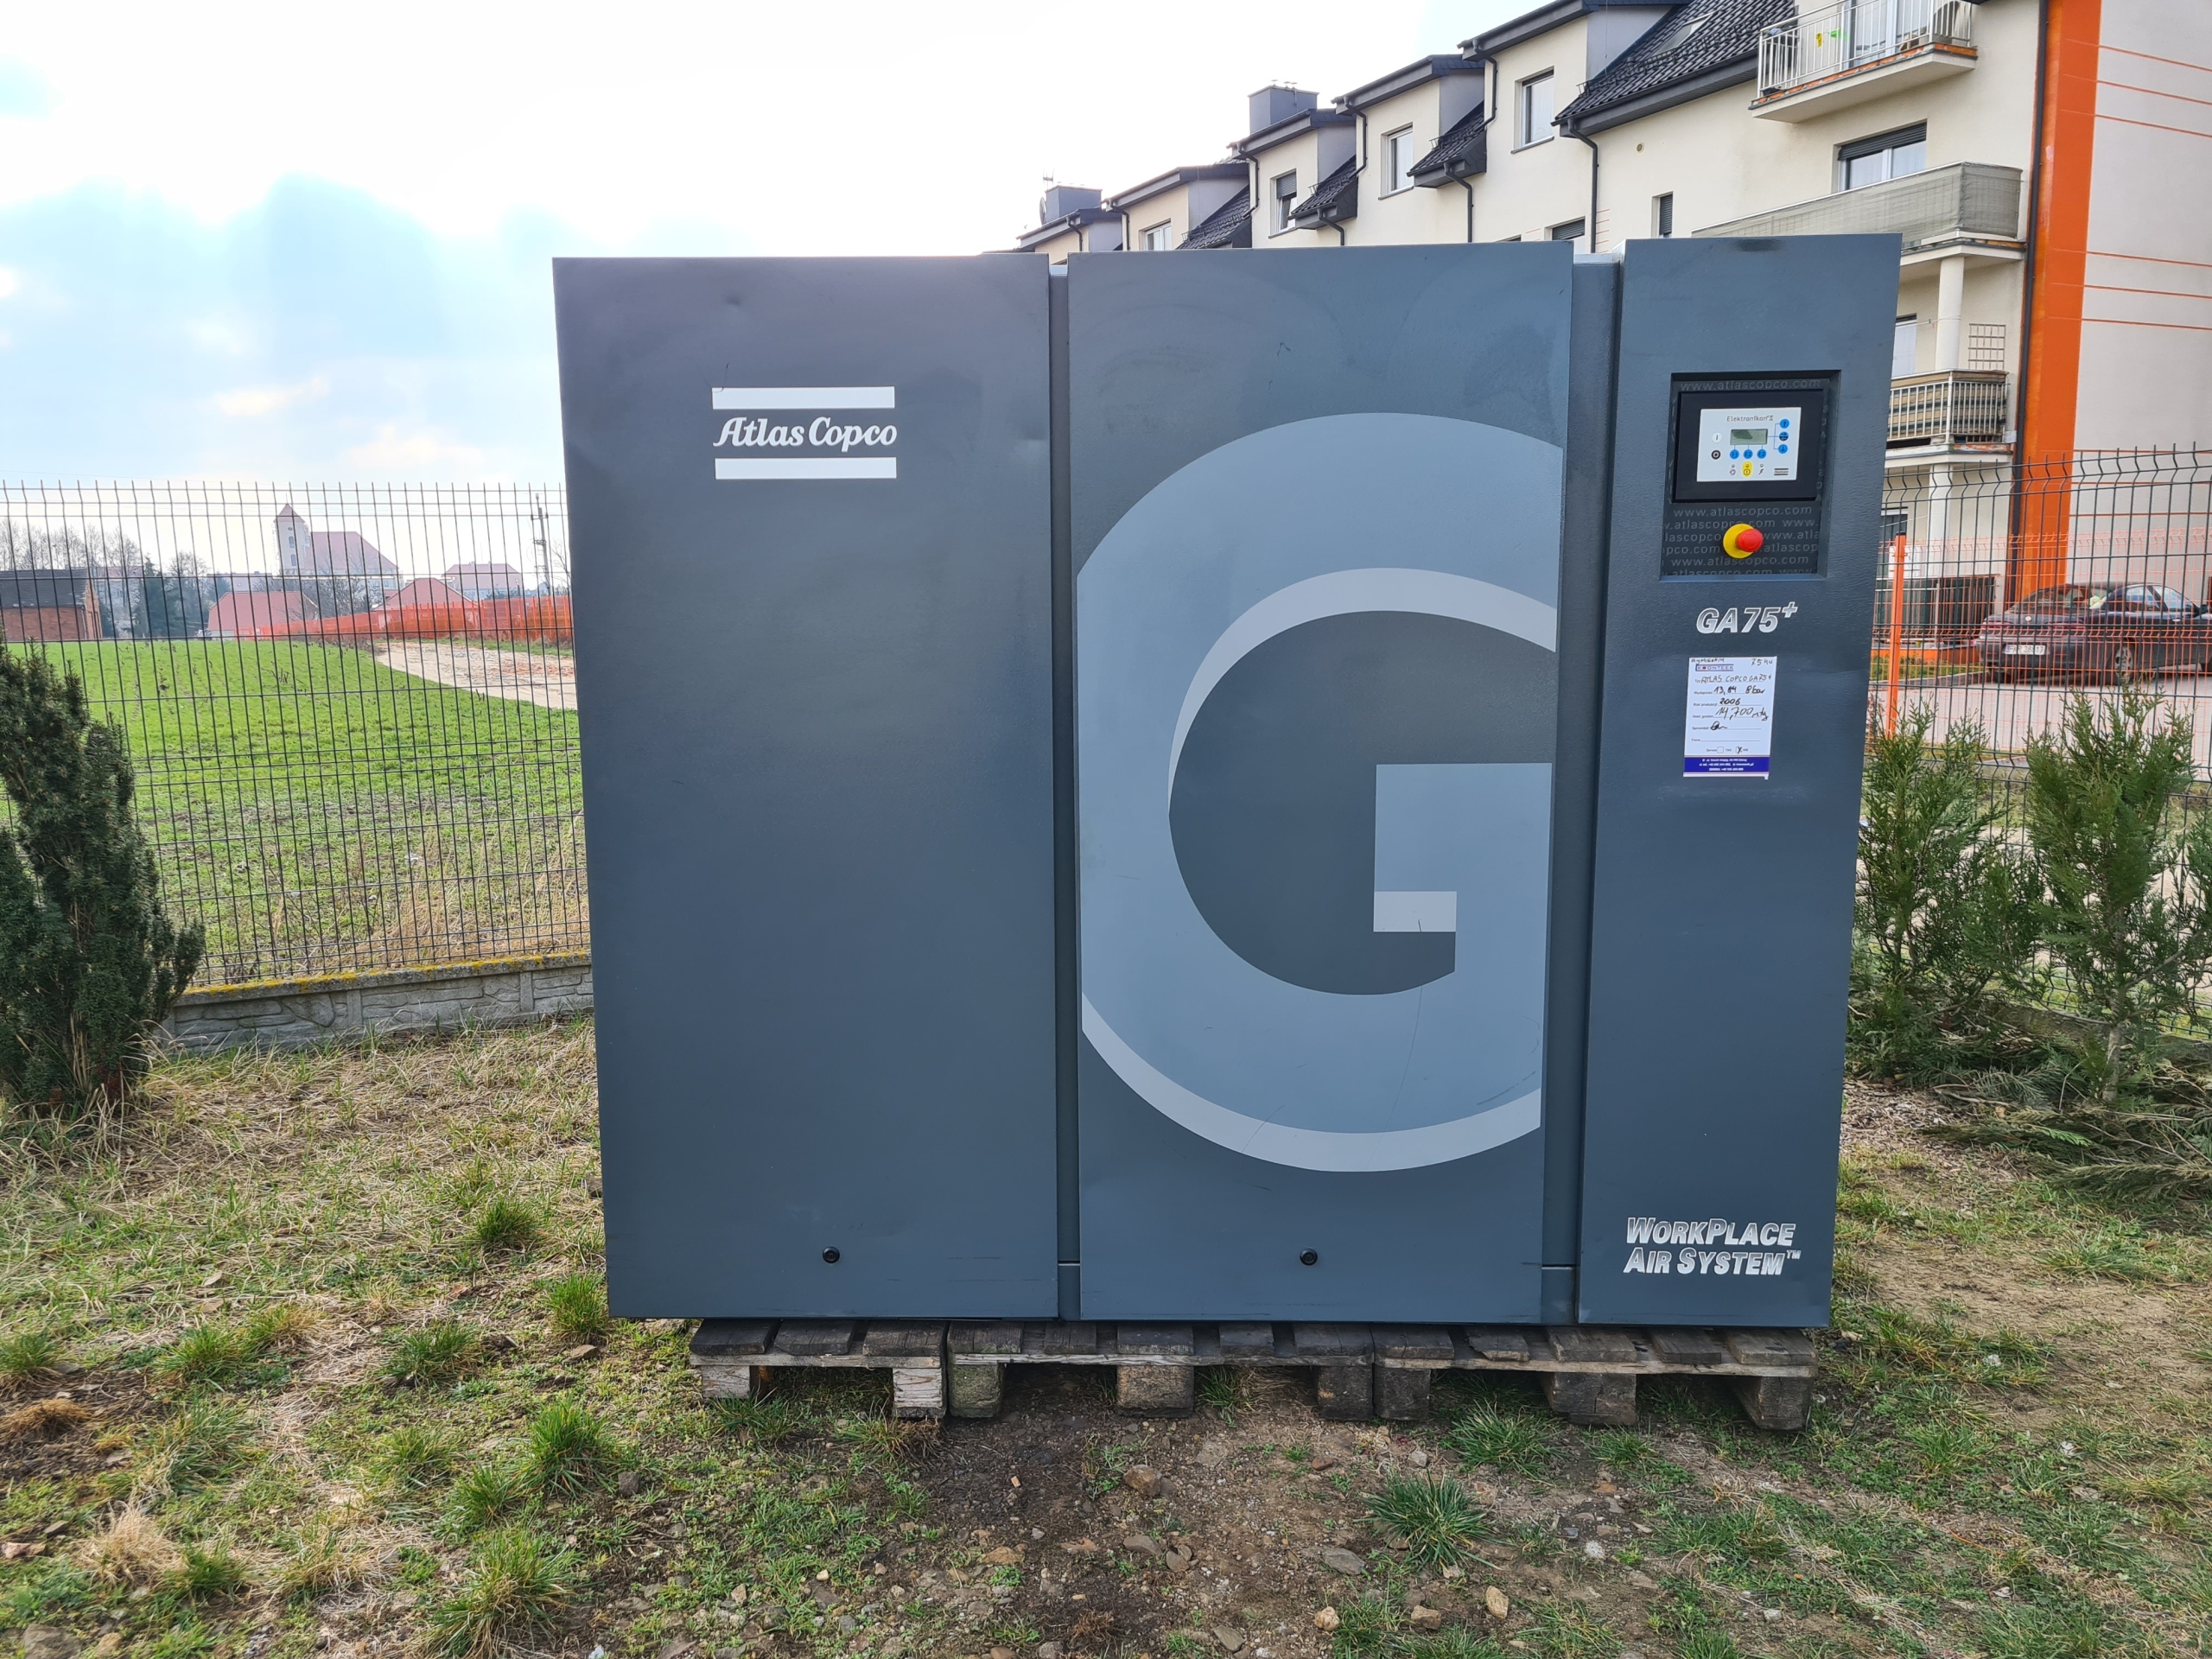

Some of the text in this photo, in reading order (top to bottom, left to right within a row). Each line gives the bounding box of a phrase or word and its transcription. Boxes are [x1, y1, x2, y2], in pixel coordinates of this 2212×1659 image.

[713, 416, 897, 453] Atlas Copco
[1674, 505, 1812, 518] www.atlascopco.com
[1696, 601, 1798, 633] GA75+
[1701, 675, 1722, 683] ATLAS
[1719, 697, 1741, 706] 2006
[1077, 413, 1563, 1173] G
